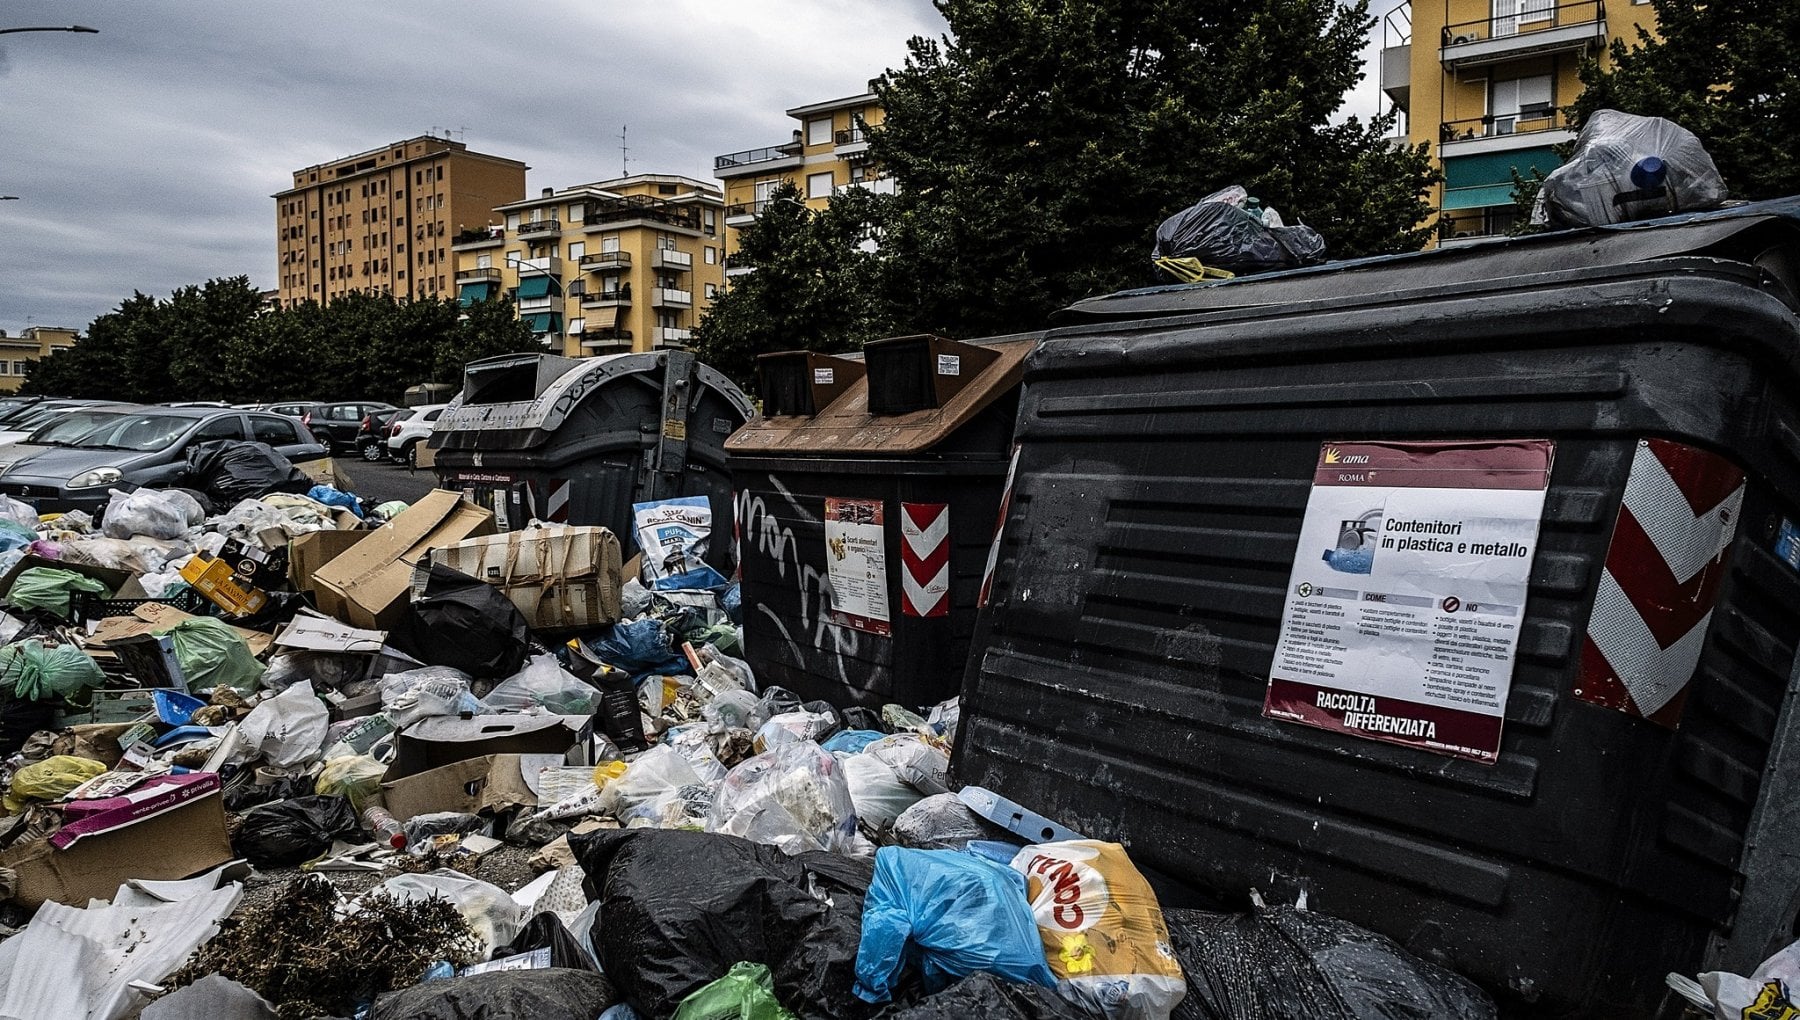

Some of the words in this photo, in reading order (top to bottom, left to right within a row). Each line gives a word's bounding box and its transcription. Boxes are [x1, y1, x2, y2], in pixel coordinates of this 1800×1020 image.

[1342, 453, 1369, 464] ama
[1338, 473, 1365, 482] ROMA
[676, 515, 702, 524] CANIN
[1385, 518, 1462, 536] Contenitori
[1381, 535, 1395, 549] in
[1398, 538, 1453, 554] plastica
[1458, 544, 1467, 554] e
[1470, 543, 1528, 558] metallo
[1365, 593, 1386, 602] COME
[1465, 604, 1478, 612] NO
[1316, 691, 1376, 713] RACCOLTA
[1344, 711, 1436, 738] DIFFERENZIATA
[190, 780, 214, 794] privalia
[1027, 854, 1084, 929] CONAD
